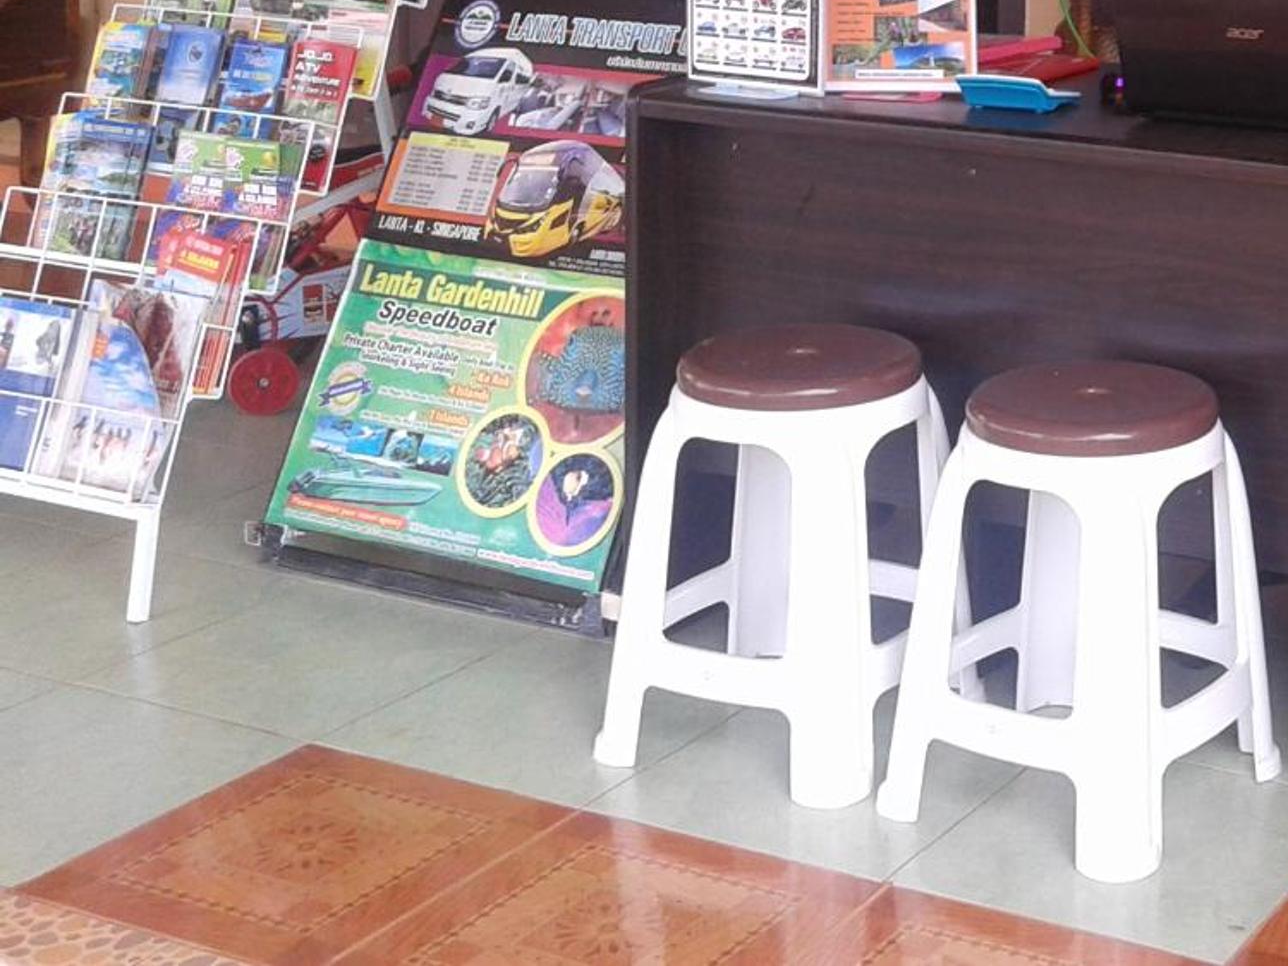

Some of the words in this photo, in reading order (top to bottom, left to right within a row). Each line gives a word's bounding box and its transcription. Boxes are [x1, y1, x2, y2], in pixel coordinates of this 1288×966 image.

[506, 13, 568, 45] LANTA
[569, 17, 681, 56] TRANSPORT
[1226, 27, 1264, 40] acer
[294, 61, 321, 73] ATV
[379, 215, 408, 232] LANTA
[431, 221, 483, 242] SINGAPORE
[360, 264, 424, 299] Lanta
[426, 274, 546, 319] Gardenhill
[379, 300, 498, 336] Speedboat
[344, 333, 376, 351] Private
[377, 338, 414, 356] Charter
[414, 346, 460, 363] Available
